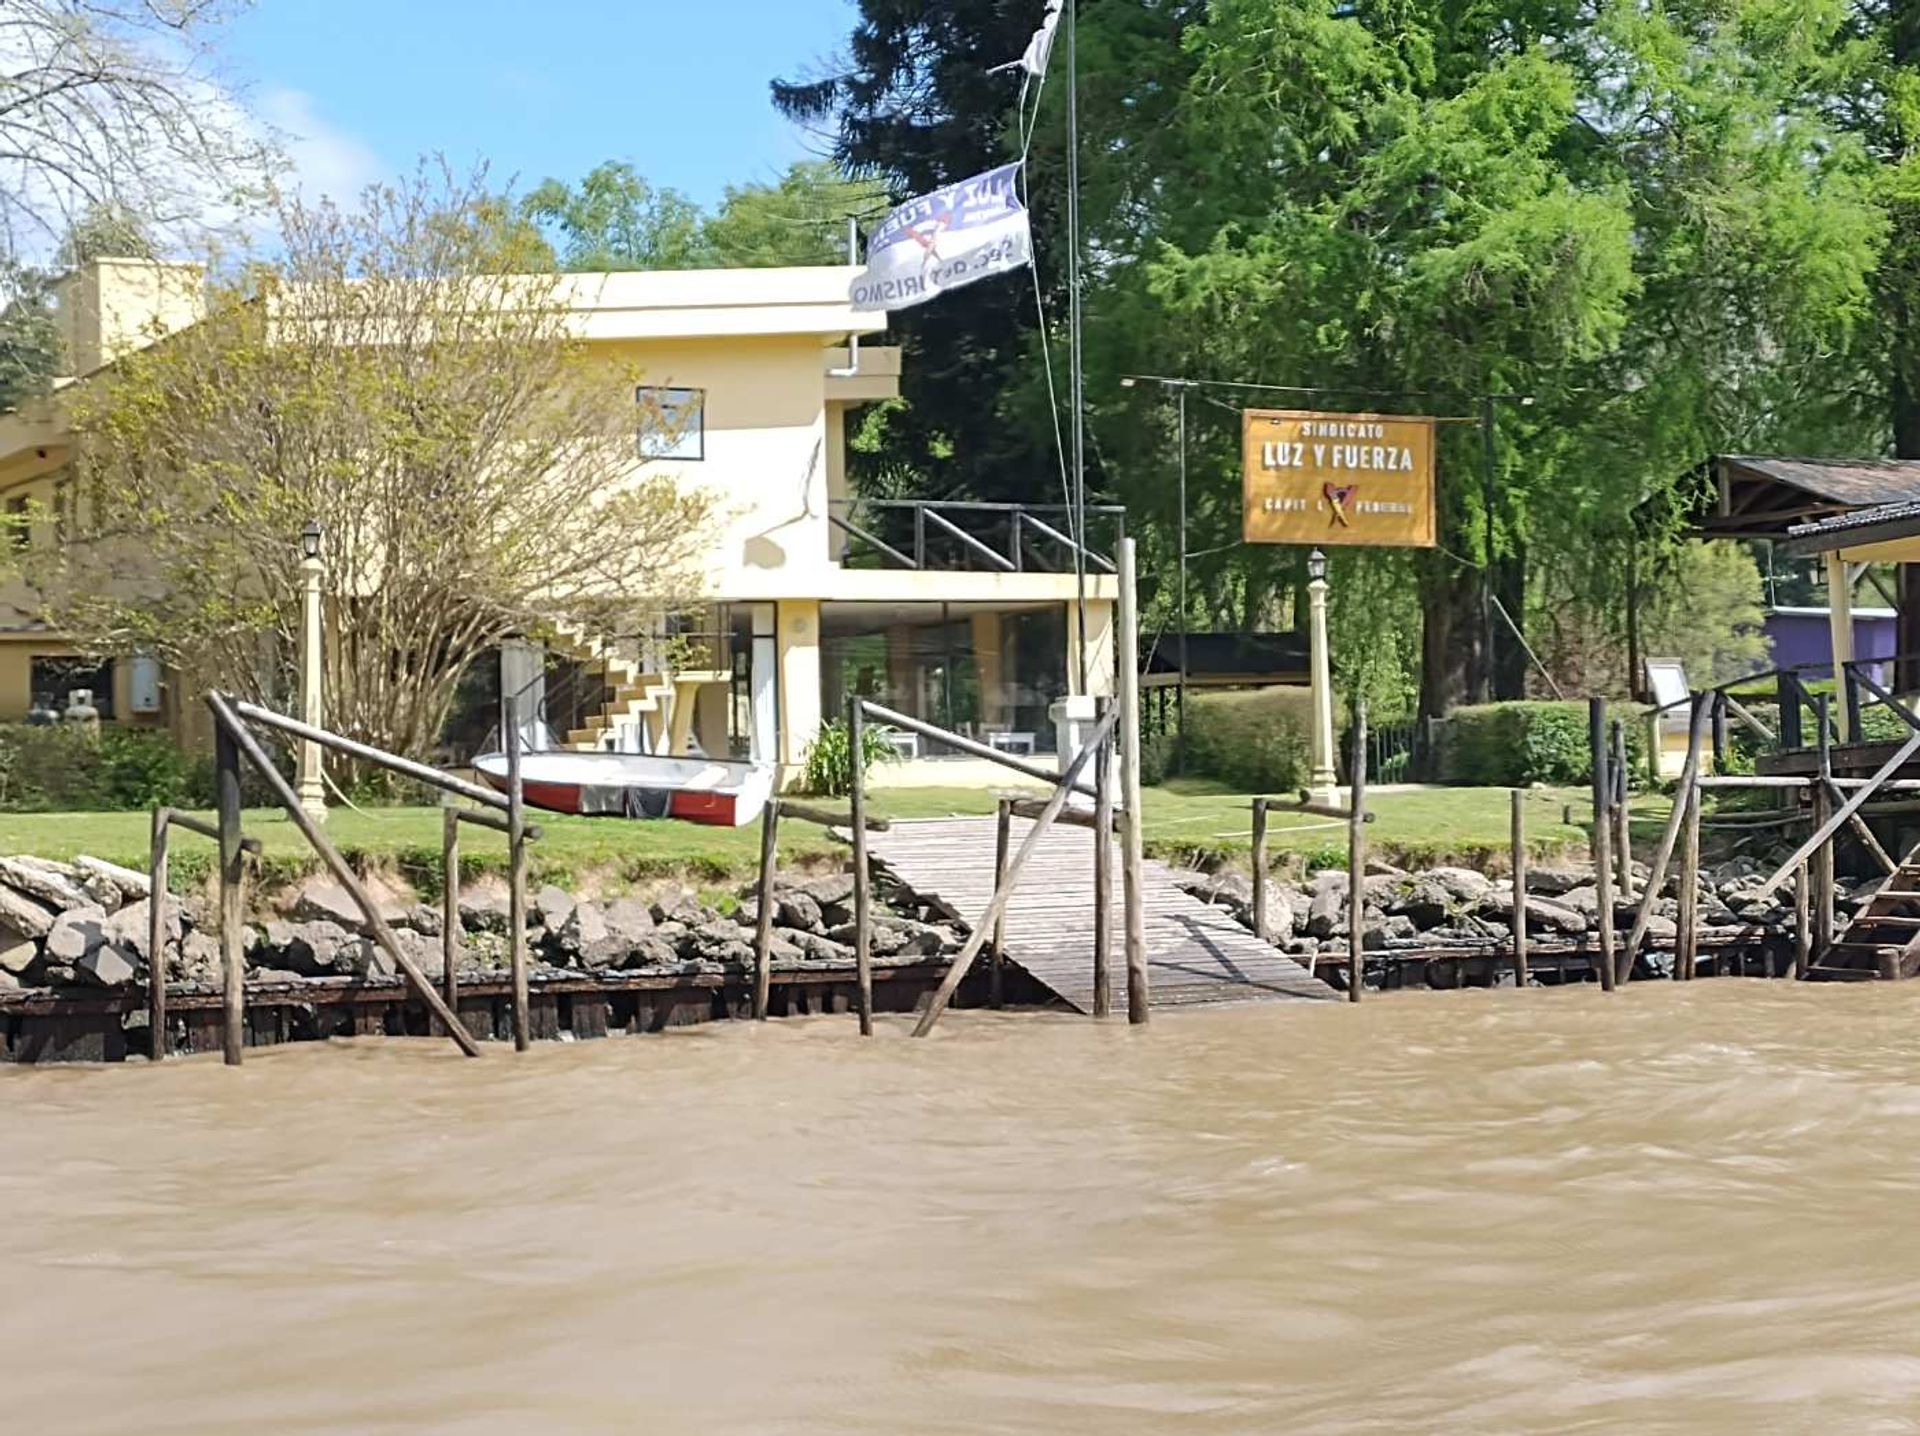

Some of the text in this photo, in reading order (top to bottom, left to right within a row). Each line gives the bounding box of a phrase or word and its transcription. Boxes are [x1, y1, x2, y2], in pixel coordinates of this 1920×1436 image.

[1302, 421, 1384, 438] SINDICATO
[1264, 441, 1413, 471] LUZ Y FUERZA
[1265, 498, 1323, 513] CAPITL
